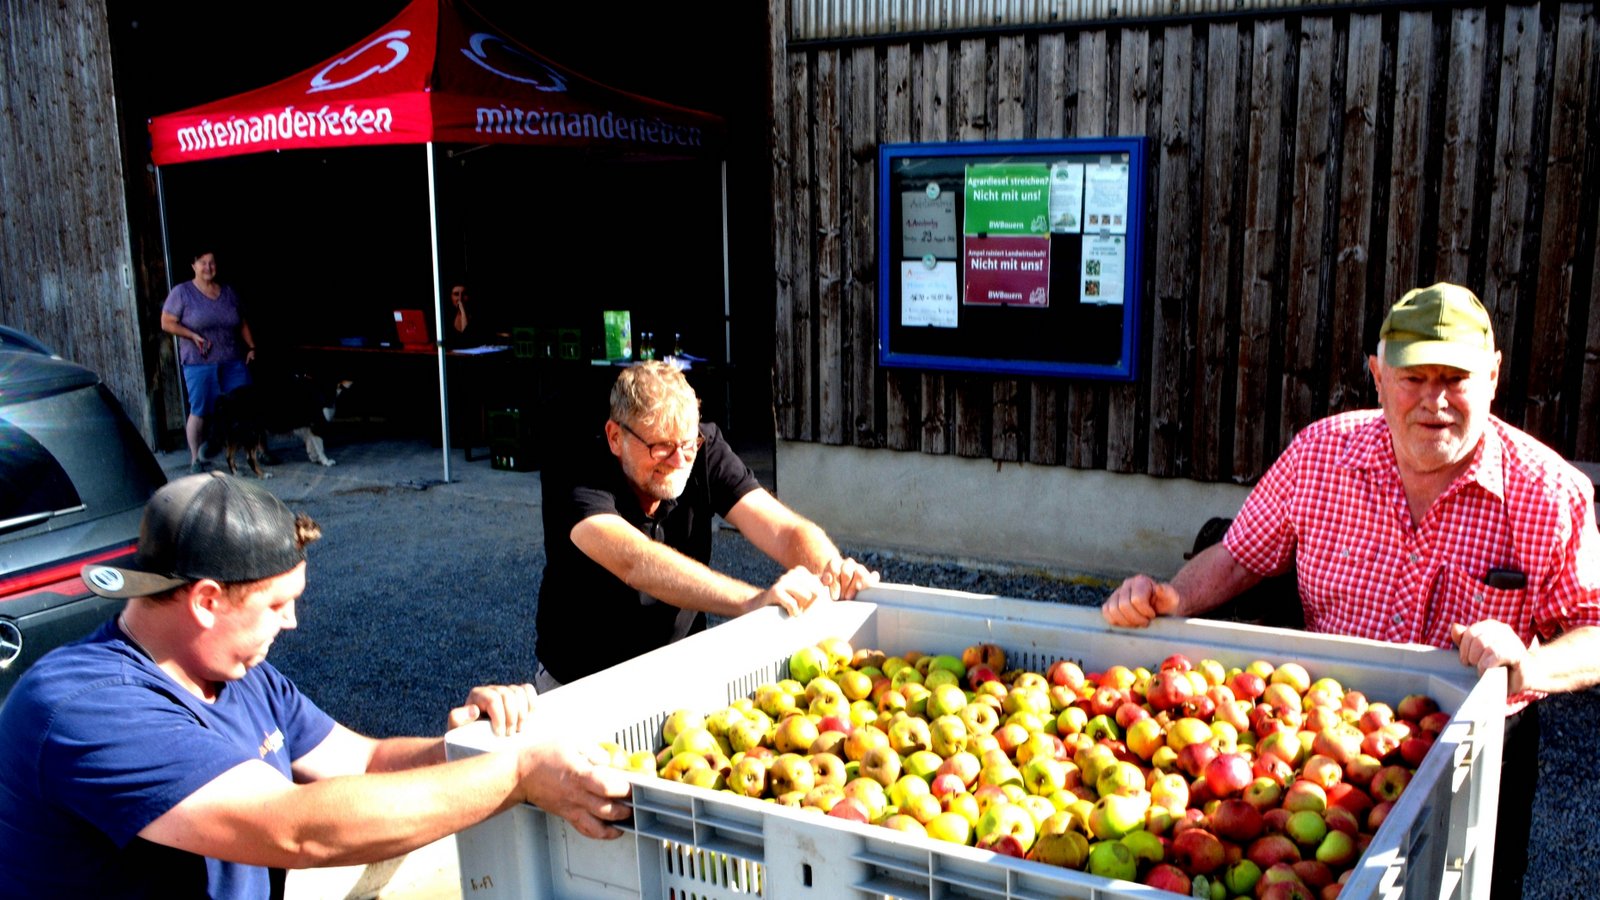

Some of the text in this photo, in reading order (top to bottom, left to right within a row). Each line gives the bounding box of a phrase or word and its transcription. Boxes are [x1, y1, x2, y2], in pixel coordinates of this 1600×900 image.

[177, 104, 393, 152] miteinanderleben
[475, 103, 702, 146] miteinanderleben
[967, 175, 1050, 188] Agrardiesel streichen?
[973, 189, 999, 201] Nicht
[1001, 189, 1019, 201] mit
[1021, 189, 1041, 201] uns!
[968, 249, 985, 258] Ampel
[971, 257, 1043, 271] Nicht mit uns!
